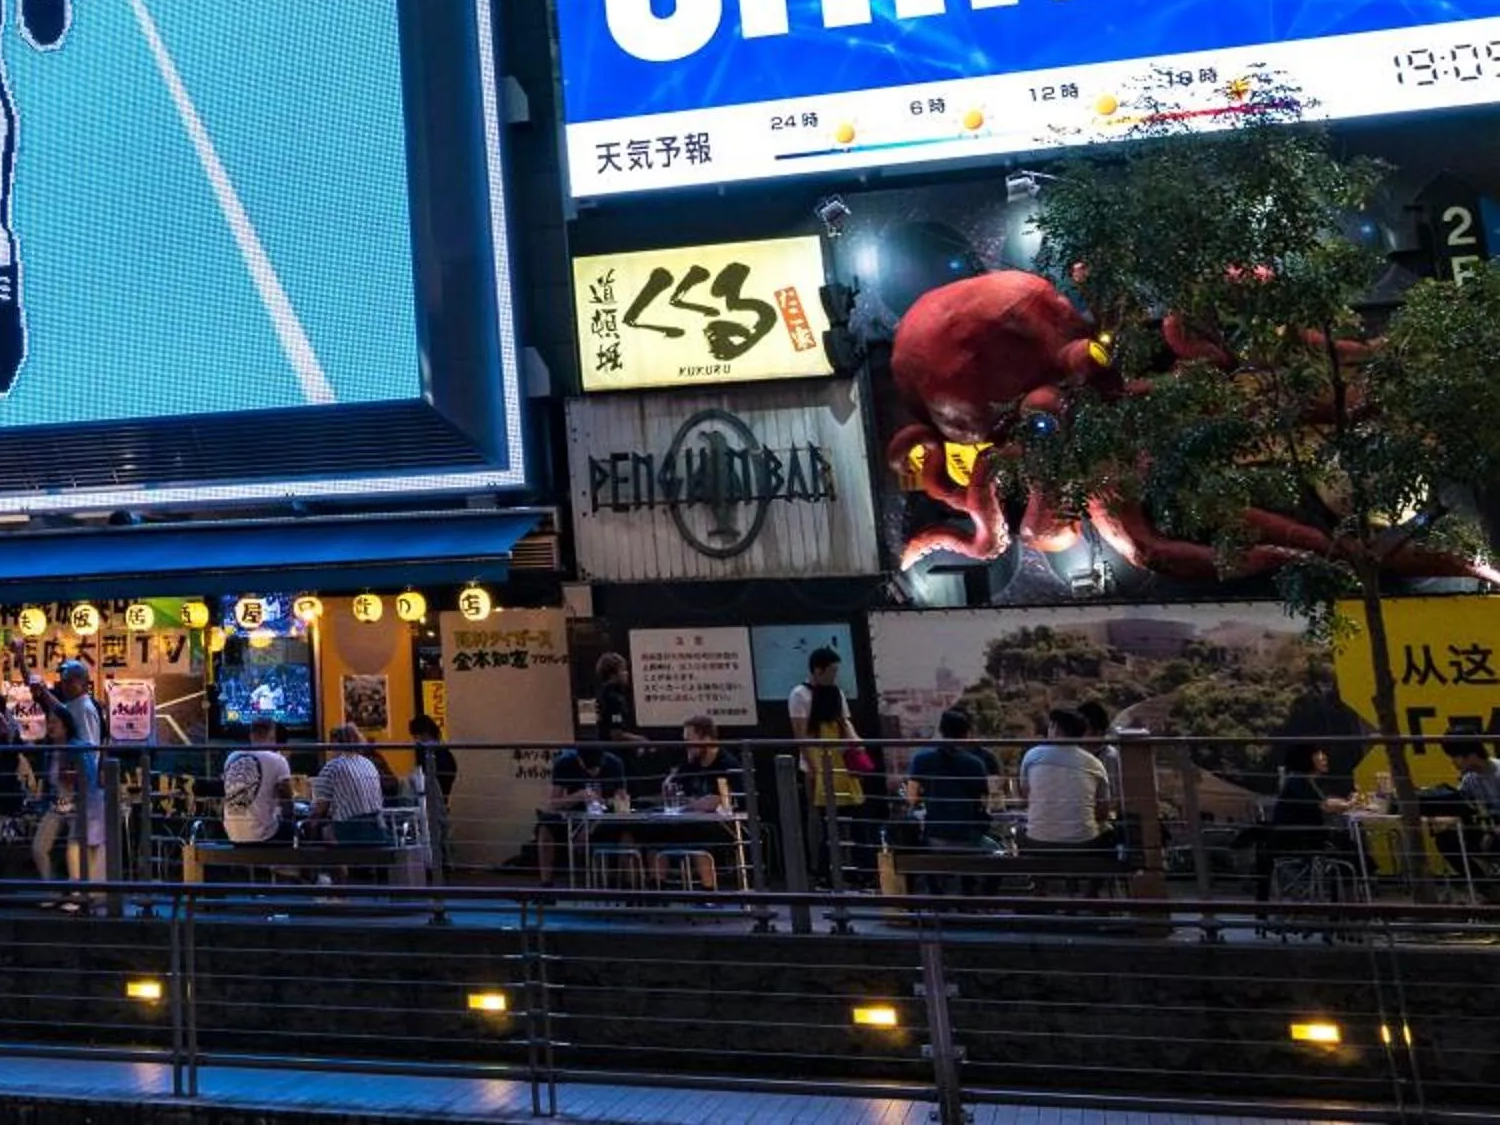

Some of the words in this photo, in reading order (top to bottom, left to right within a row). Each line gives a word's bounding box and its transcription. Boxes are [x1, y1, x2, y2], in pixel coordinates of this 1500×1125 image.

[595, 131, 713, 175] 天気予報
[588, 268, 624, 372] 道頓堀
[622, 261, 778, 362] くくる
[678, 363, 732, 378] KUKURU
[760, 439, 837, 504] BAR
[1401, 642, 1500, 686] 从这
